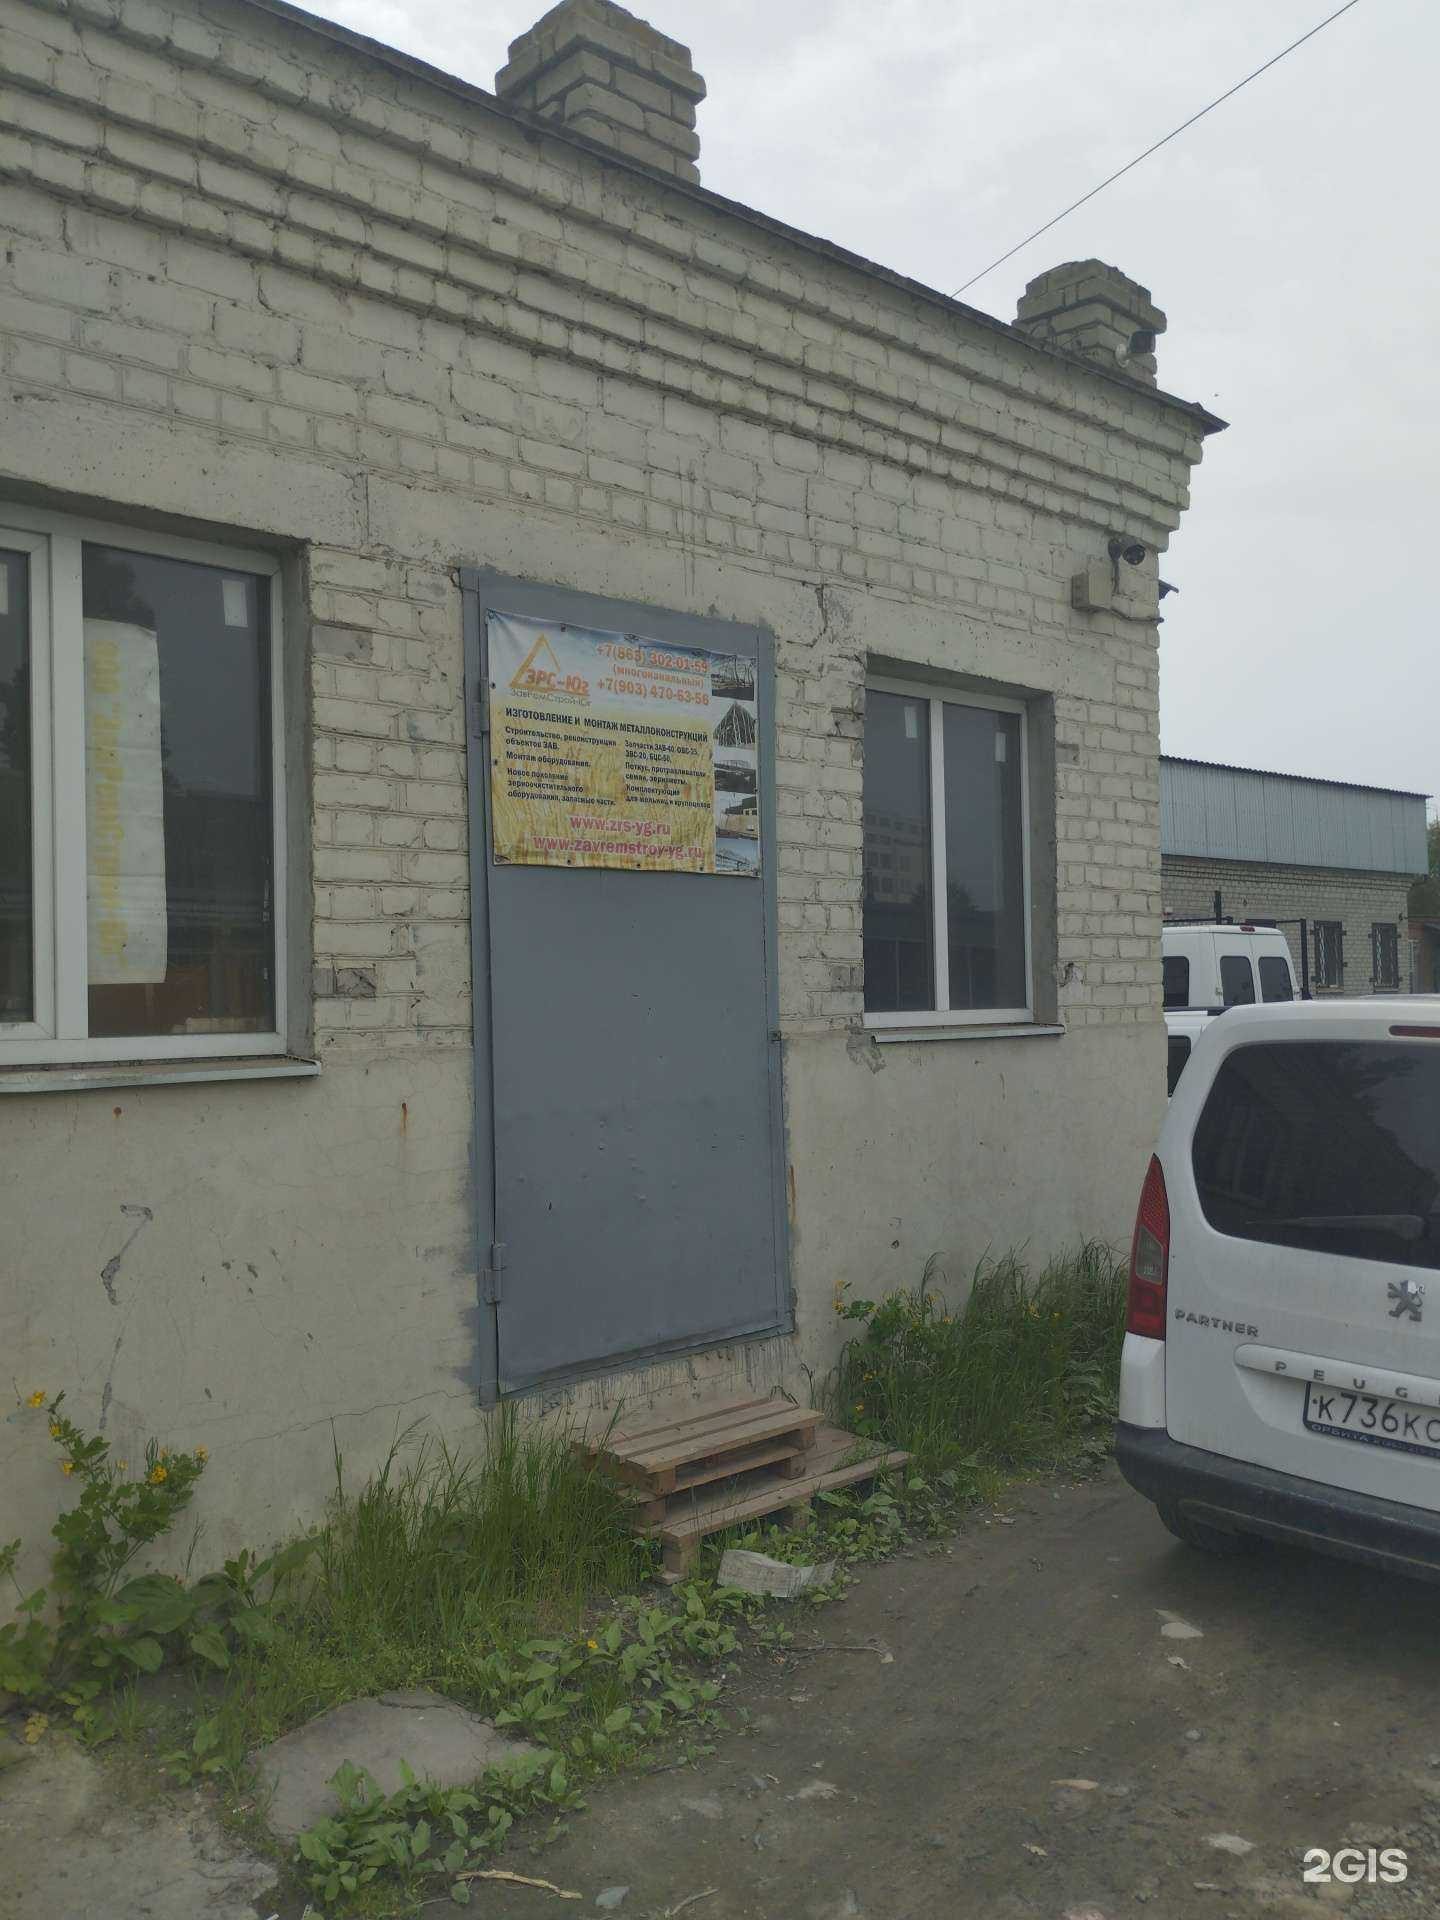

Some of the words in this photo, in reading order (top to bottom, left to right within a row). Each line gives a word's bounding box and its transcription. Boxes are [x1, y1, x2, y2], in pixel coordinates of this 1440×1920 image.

[597, 677, 647, 698] +7(903)
[650, 684, 710, 706] 470-63-56
[505, 707, 573, 726] ИЗГОТОВЛЕНИЕ
[575, 717, 581, 726] И
[584, 718, 619, 732] МОНТАЖ
[506, 751, 537, 762] Монтаж
[507, 767, 530, 777] Новое
[570, 815, 671, 837] www.zrs-yg.ru
[1174, 1307, 1259, 1338] PARTNER
[1275, 1360, 1440, 1407] PEUG
